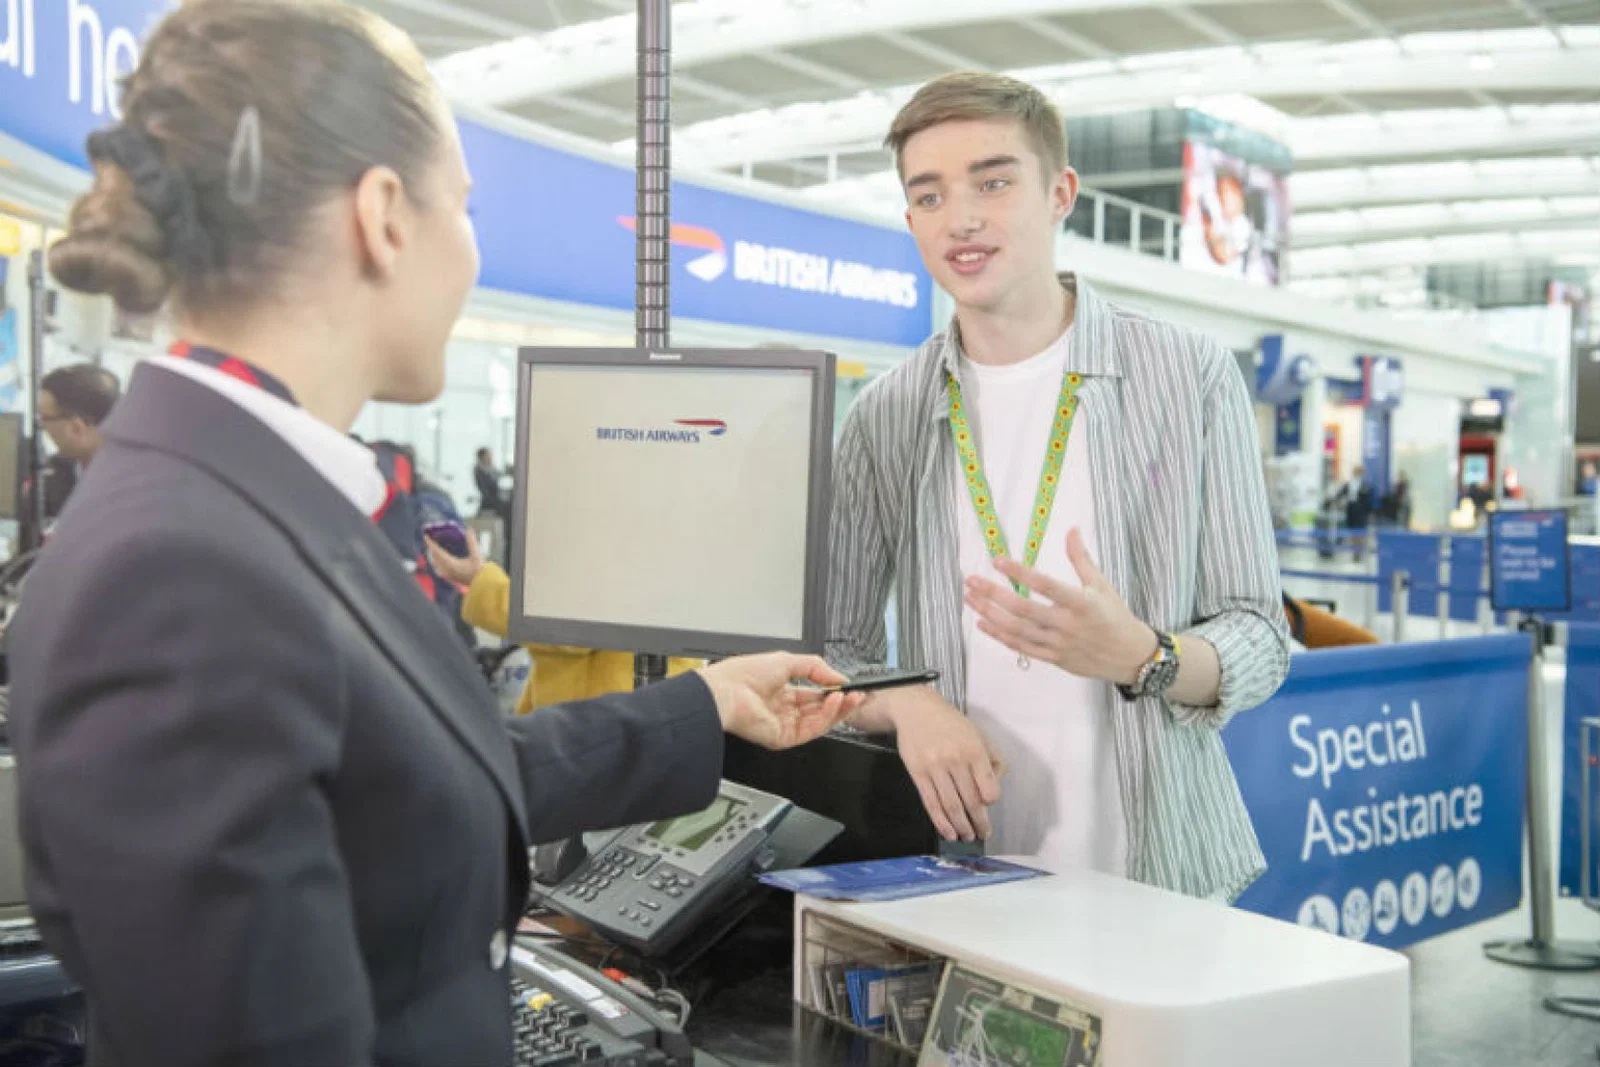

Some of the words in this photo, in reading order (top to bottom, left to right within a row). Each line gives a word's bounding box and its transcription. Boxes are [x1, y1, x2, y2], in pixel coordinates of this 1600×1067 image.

[735, 241, 828, 292] BRITISH
[596, 427, 643, 442] BRITISH
[646, 429, 700, 443] AIRWAYS
[1288, 700, 1428, 789] Special
[1301, 784, 1483, 862] Assistance
